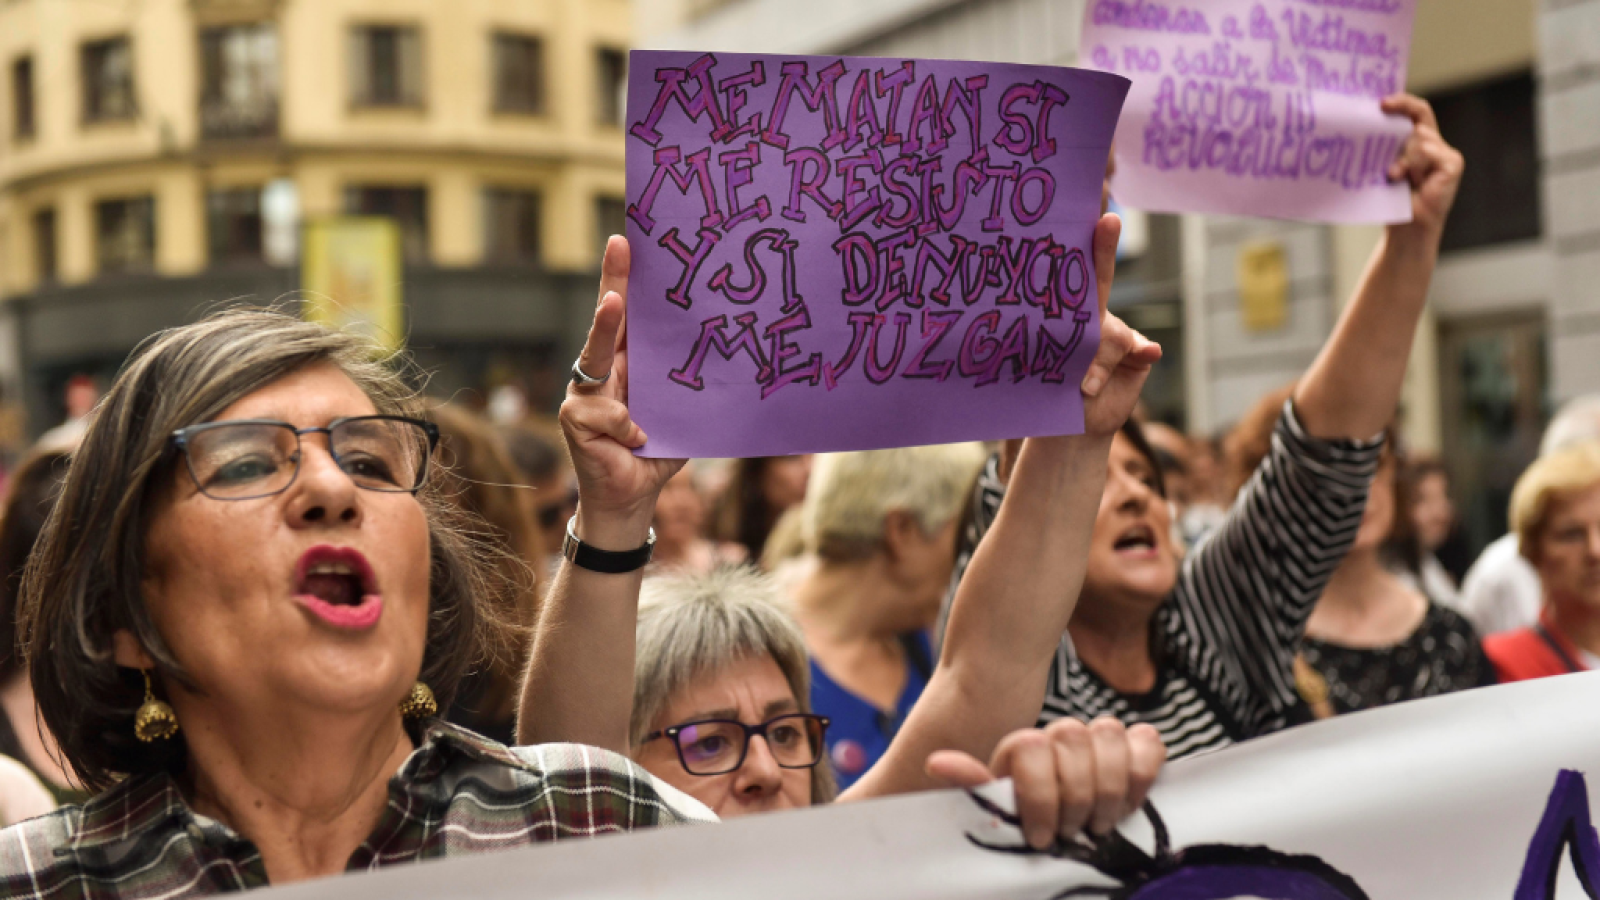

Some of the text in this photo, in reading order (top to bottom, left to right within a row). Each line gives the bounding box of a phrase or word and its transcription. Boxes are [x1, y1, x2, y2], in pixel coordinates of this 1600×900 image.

[1123, 46, 1161, 73] no
[630, 53, 1069, 162] ME MATAN SI
[627, 142, 1056, 235] ME RESISTO
[659, 225, 1089, 319] Y SI DENUNCIO
[668, 306, 1091, 399] ME JUZGAN
